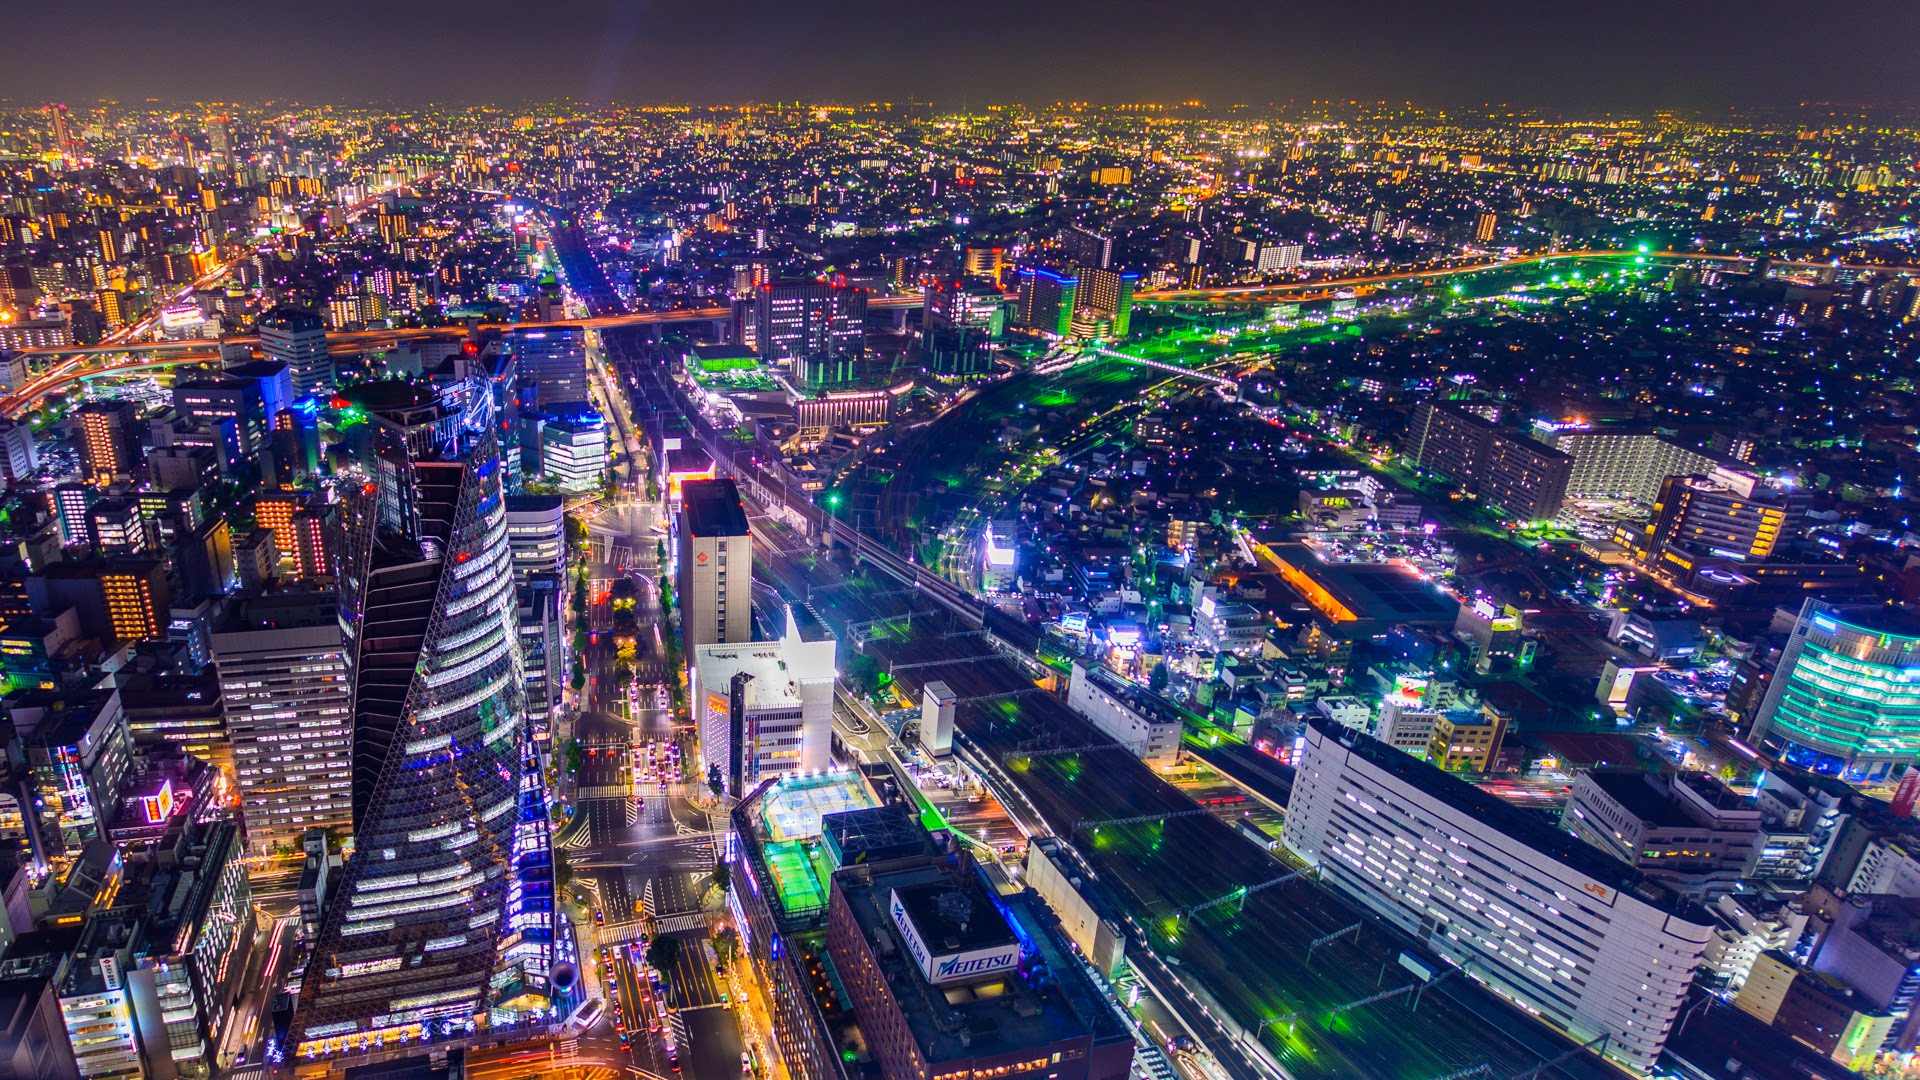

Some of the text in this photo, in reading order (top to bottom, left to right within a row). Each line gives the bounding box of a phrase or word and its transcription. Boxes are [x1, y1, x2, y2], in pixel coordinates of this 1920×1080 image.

[1584, 883, 1606, 898] JR
[892, 902, 925, 964] MEITETSU
[936, 953, 1013, 977] MEITETSU
